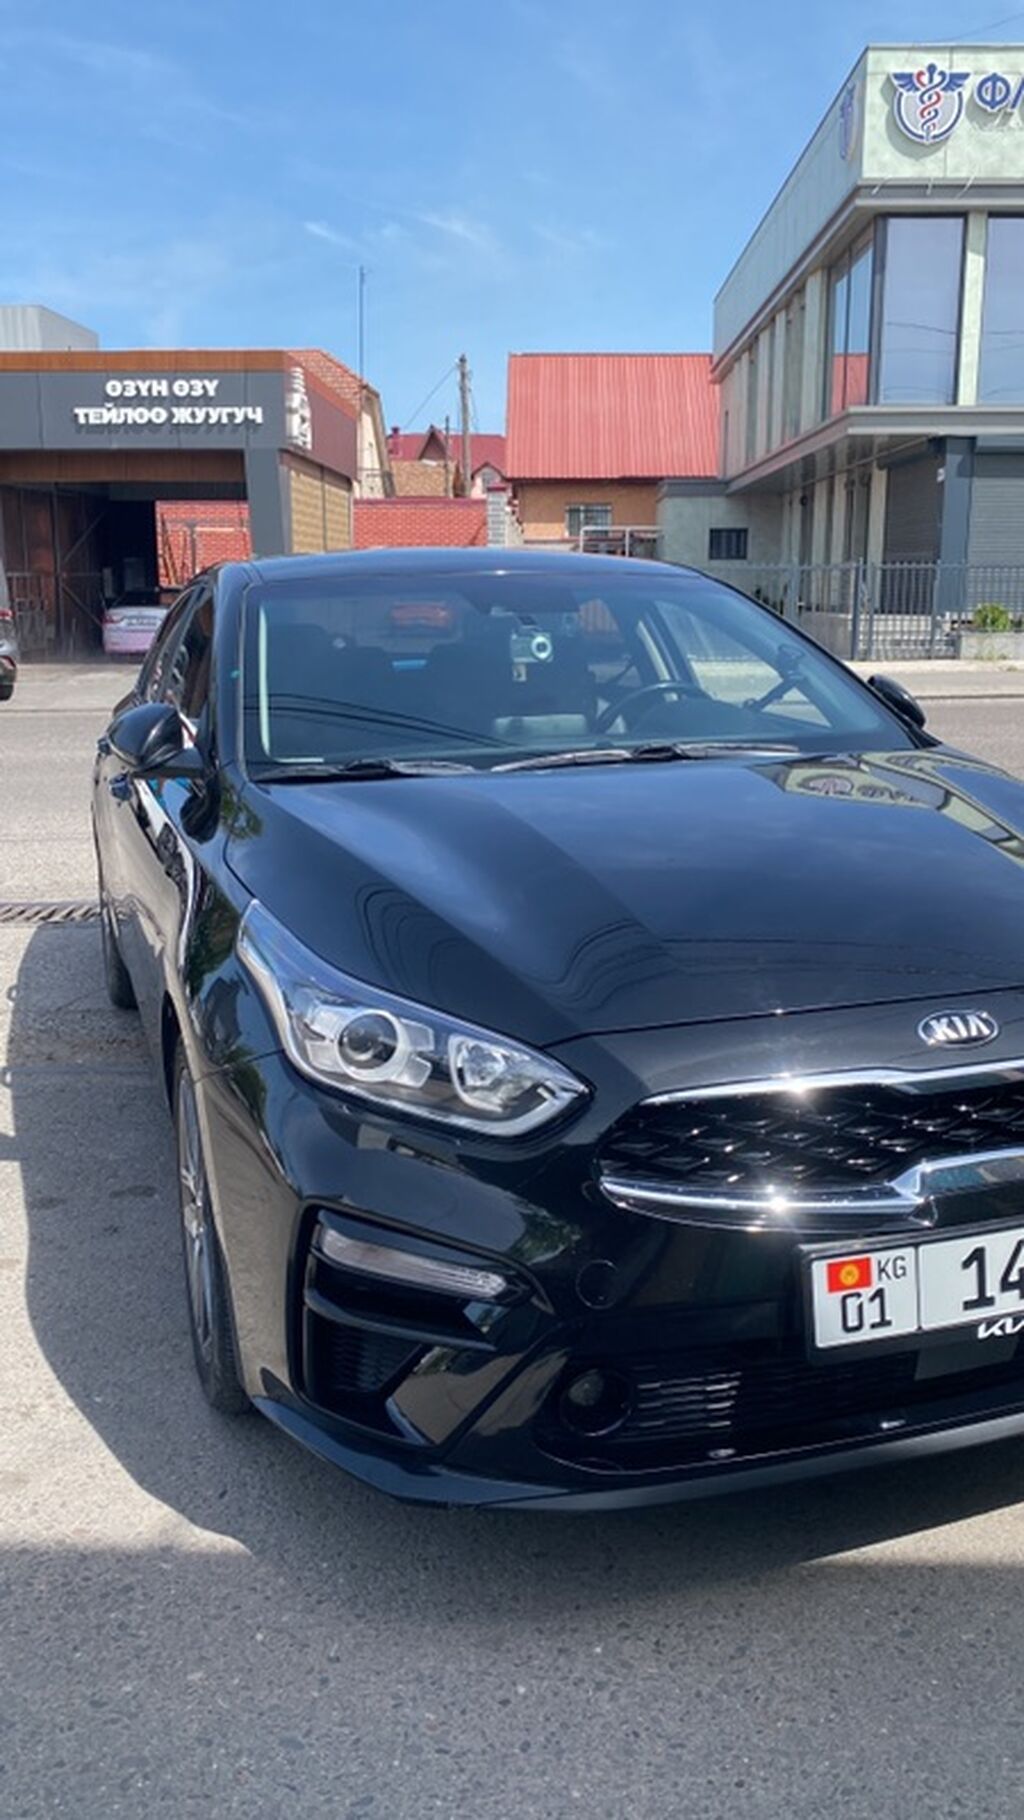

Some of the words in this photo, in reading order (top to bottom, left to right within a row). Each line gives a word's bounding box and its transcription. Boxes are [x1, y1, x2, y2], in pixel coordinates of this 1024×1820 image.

[172, 406, 264, 424] ЖУУГУЧ
[929, 1014, 990, 1041] KIA
[877, 1256, 907, 1282] KG
[841, 1287, 892, 1333] 01
